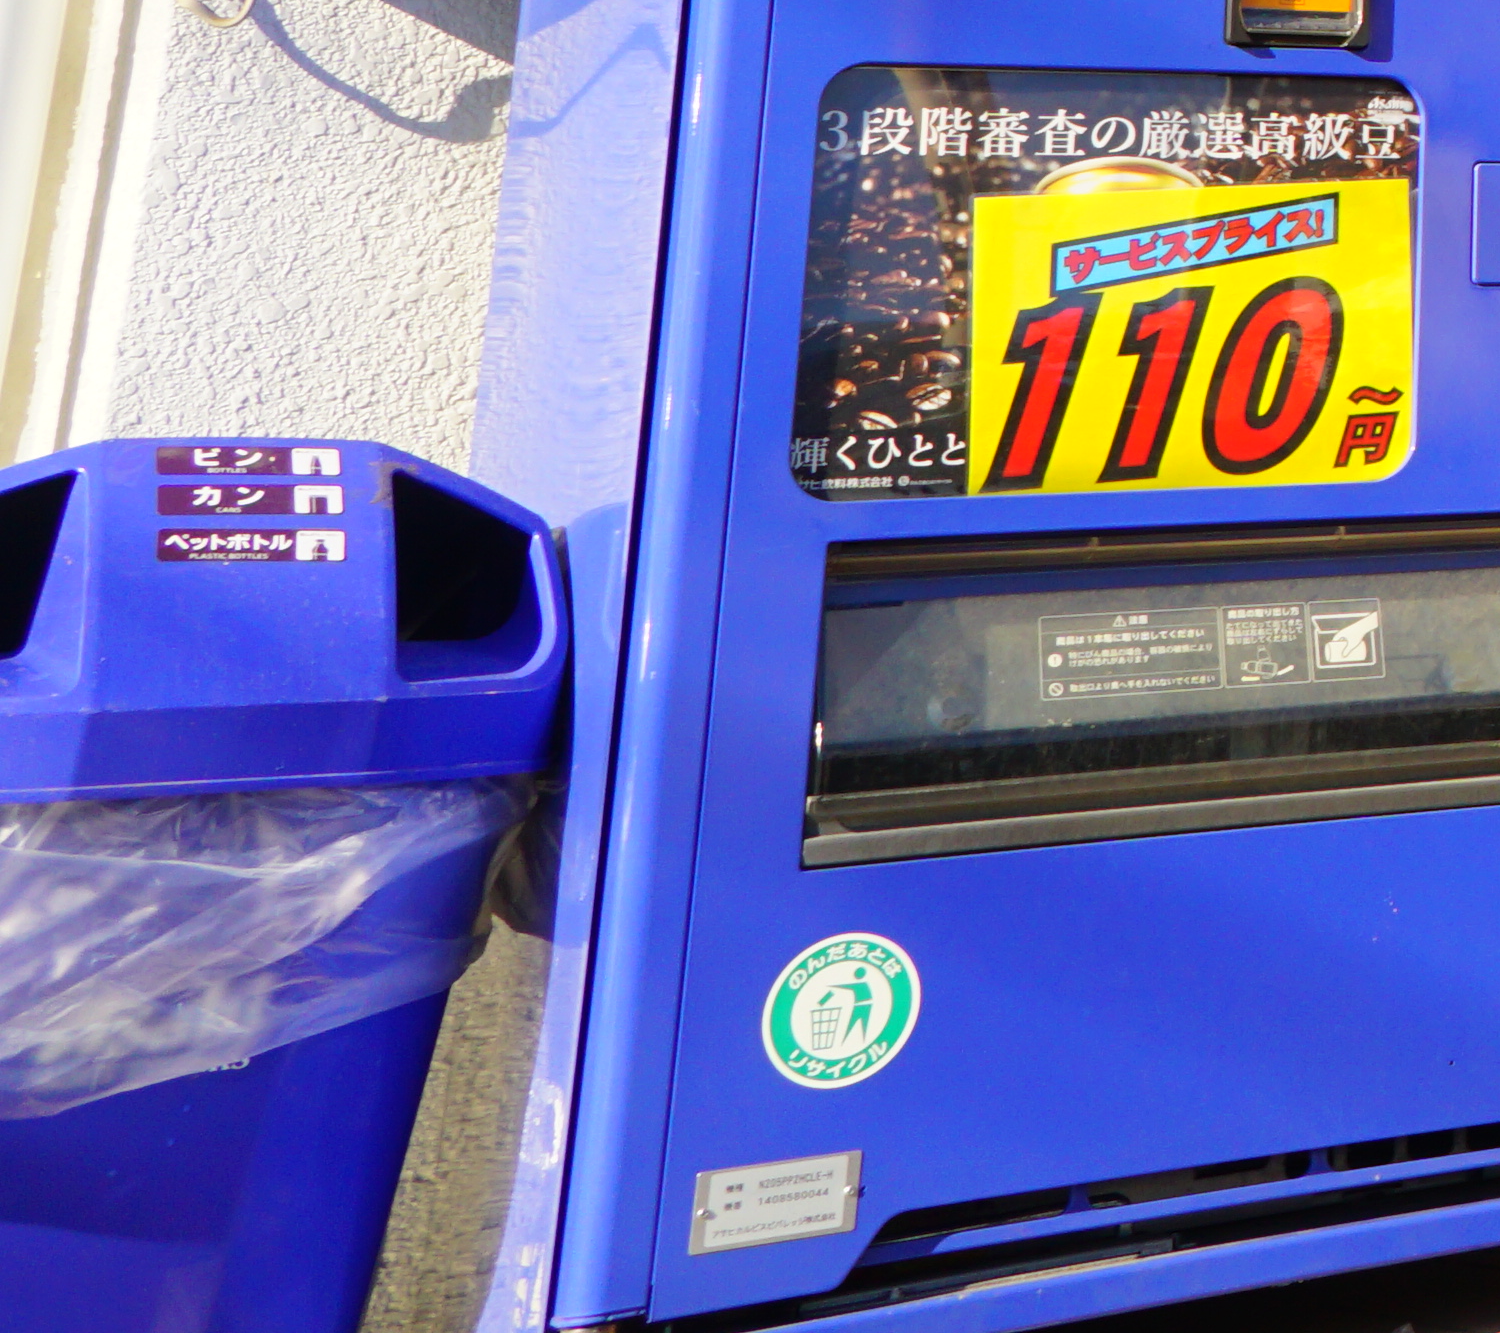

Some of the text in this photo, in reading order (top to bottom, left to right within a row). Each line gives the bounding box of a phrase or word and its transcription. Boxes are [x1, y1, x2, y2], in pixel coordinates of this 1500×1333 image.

[821, 109, 1400, 161] 3段階審査の厳選高級豆
[1063, 204, 1328, 287] サービスプライス!
[980, 276, 1345, 495] 110
[193, 447, 263, 467] ビン
[192, 485, 265, 507] カン
[164, 533, 293, 552] ペットボトル
[789, 942, 903, 991] のんだあとは
[787, 1040, 888, 1079] リサイクル
